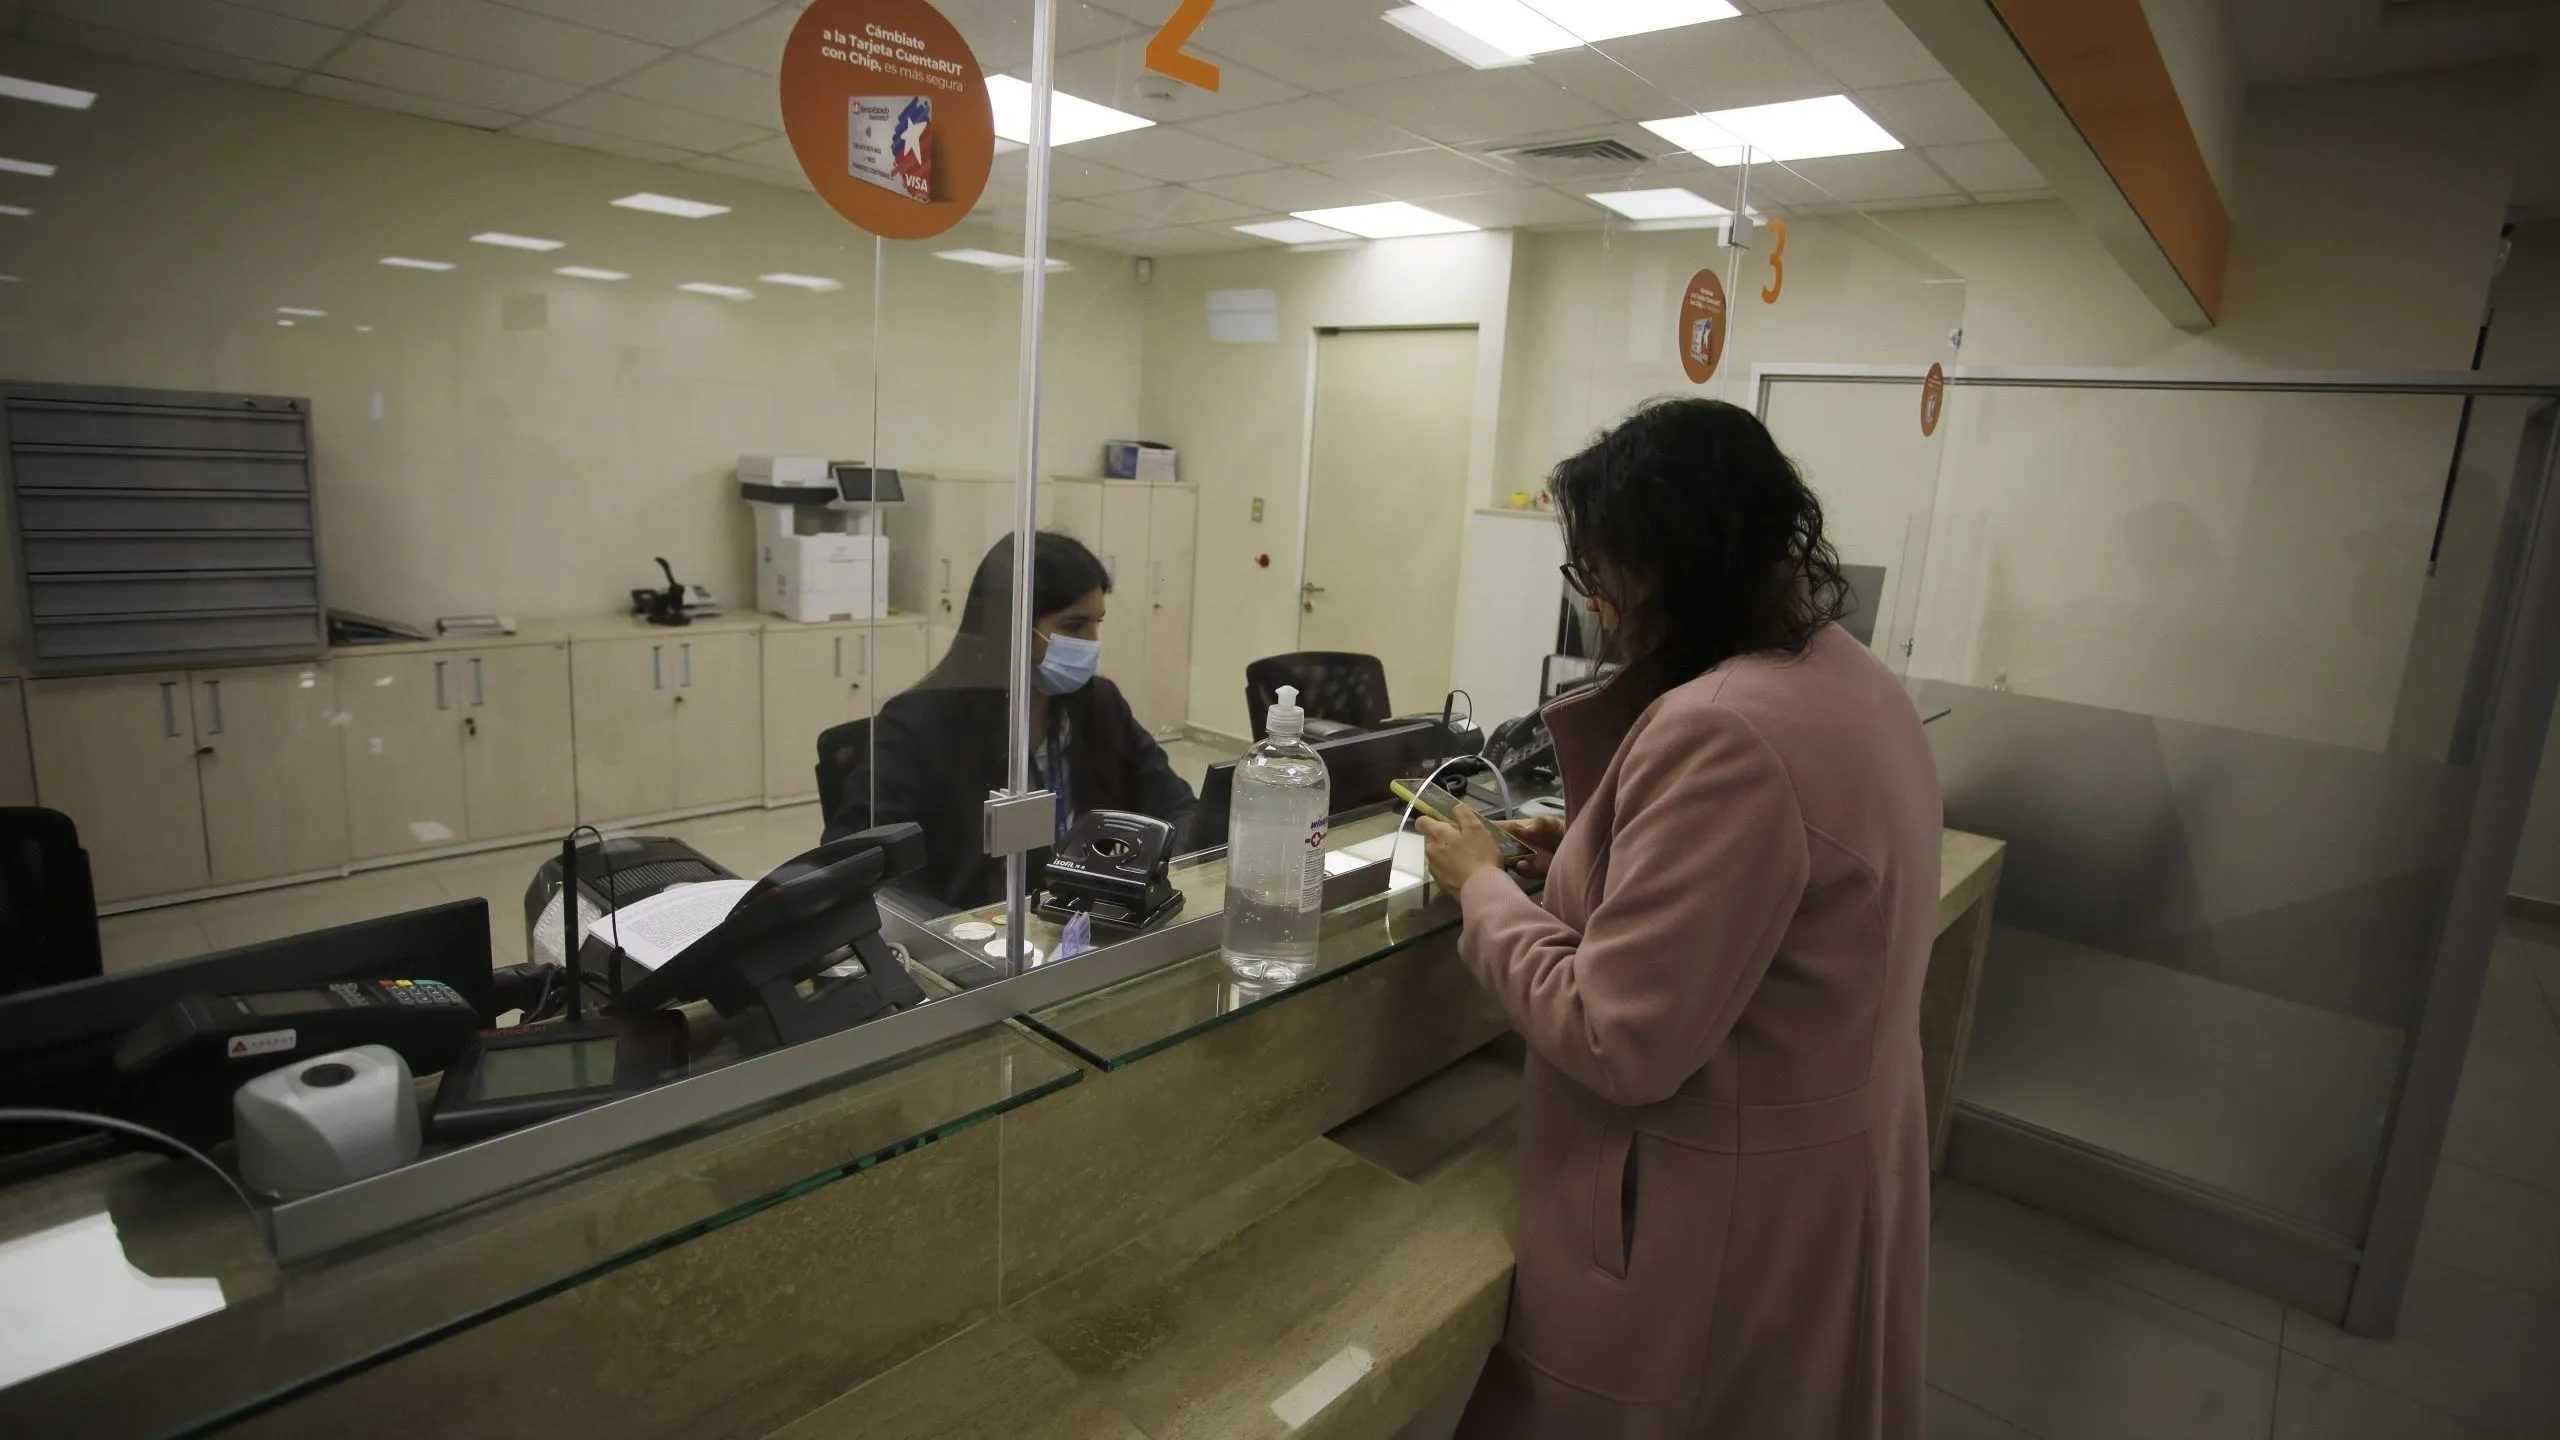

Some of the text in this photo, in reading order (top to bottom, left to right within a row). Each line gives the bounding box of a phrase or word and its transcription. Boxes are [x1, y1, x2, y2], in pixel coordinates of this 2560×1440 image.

[823, 29, 963, 76] a la Tarjeta CuentaRUT
[866, 23, 925, 51] Cámbiate
[821, 46, 963, 92] con Chip, es más segura
[905, 173, 928, 193] VISA
[1761, 218, 1786, 304] 3
